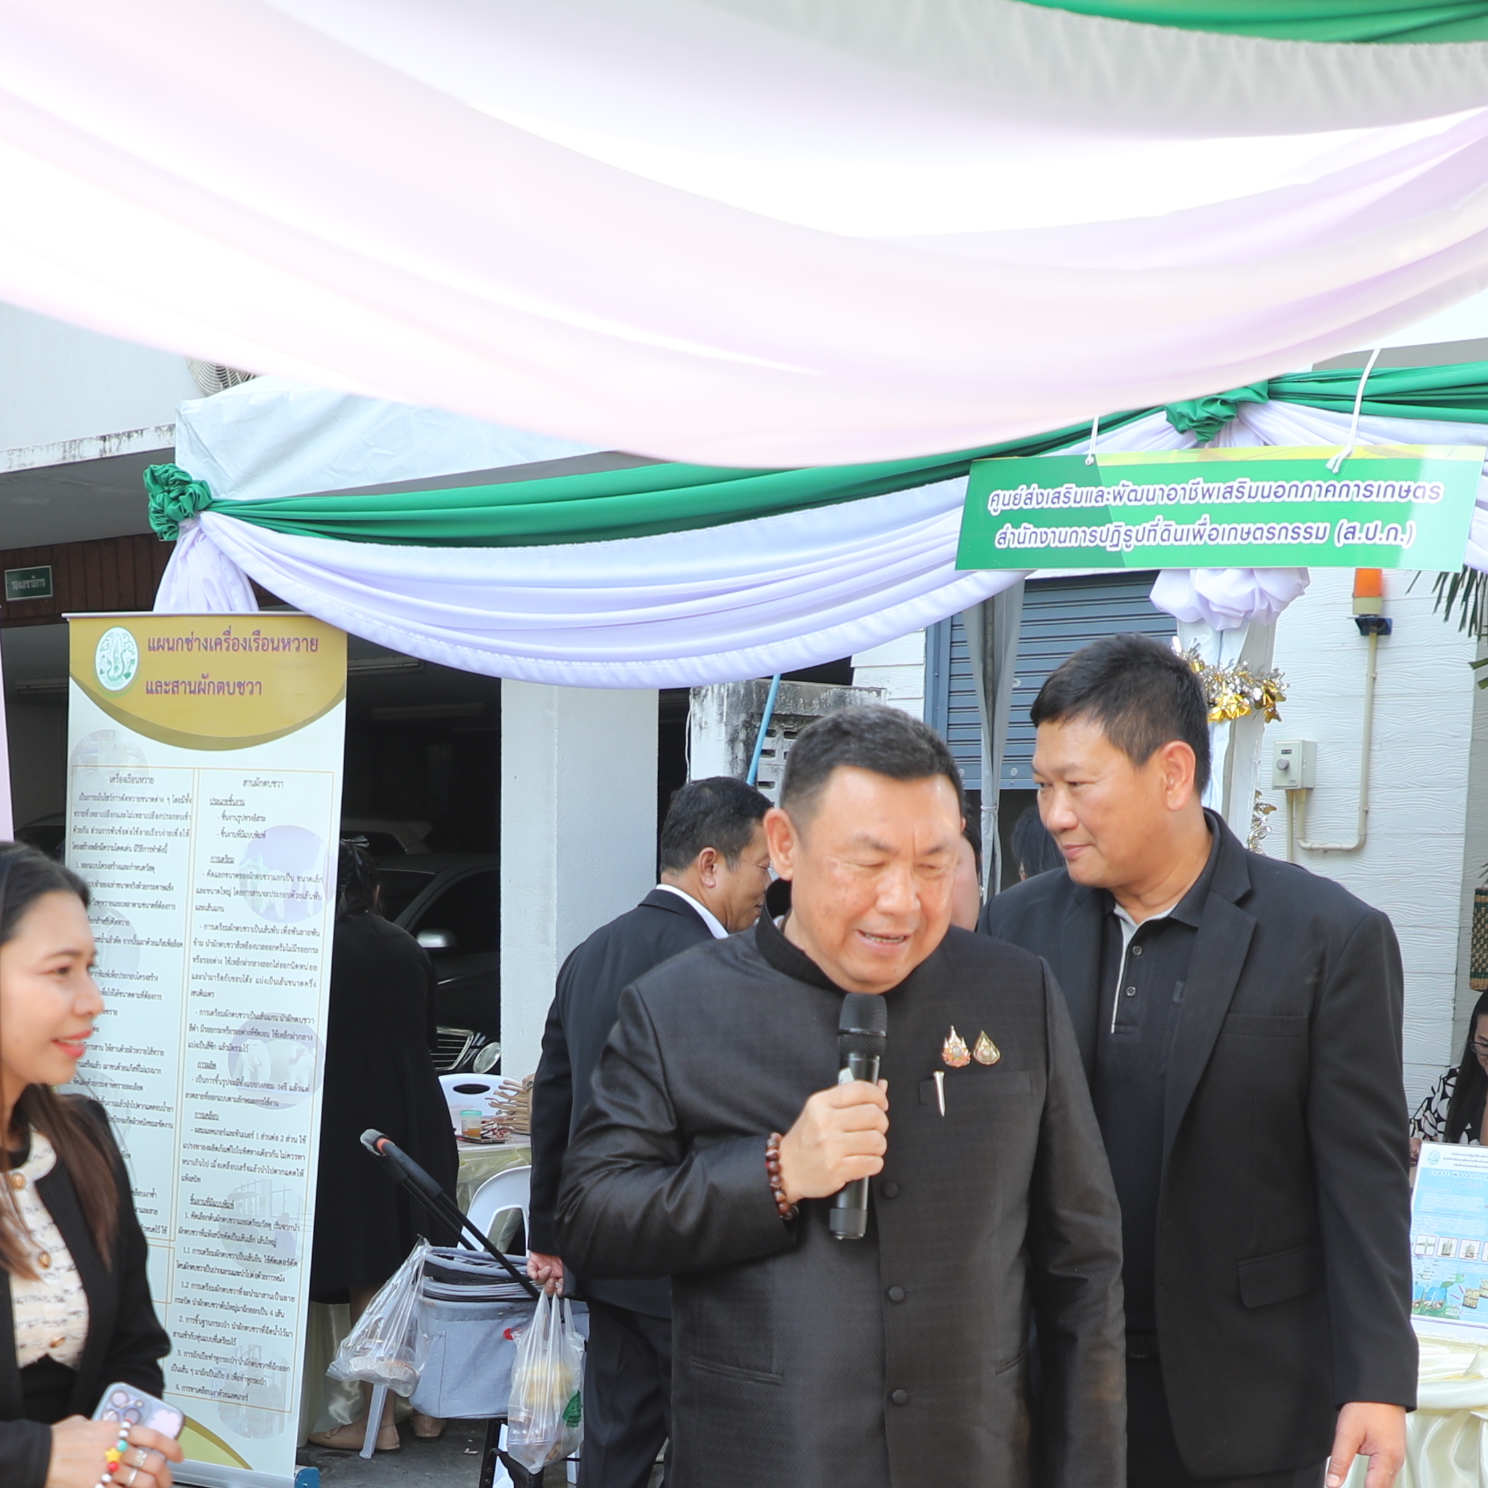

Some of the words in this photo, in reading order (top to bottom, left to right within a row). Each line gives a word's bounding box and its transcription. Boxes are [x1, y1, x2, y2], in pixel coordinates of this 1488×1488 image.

[988, 481, 1443, 515] ศูนย์ส่งเสริมและพัฒนาอาชีพเสริมนอกภาคการเกษตร
[996, 514, 1330, 552] สำนักงานการปฏิรูปที่ดินเพื่อเกษตรกรรม
[1335, 520, 1417, 548] (ส.ป.ก.)
[148, 626, 319, 652] แผนกช่างเครื่องเรือนหวาย
[146, 674, 263, 695] และสานผักตบชวา
